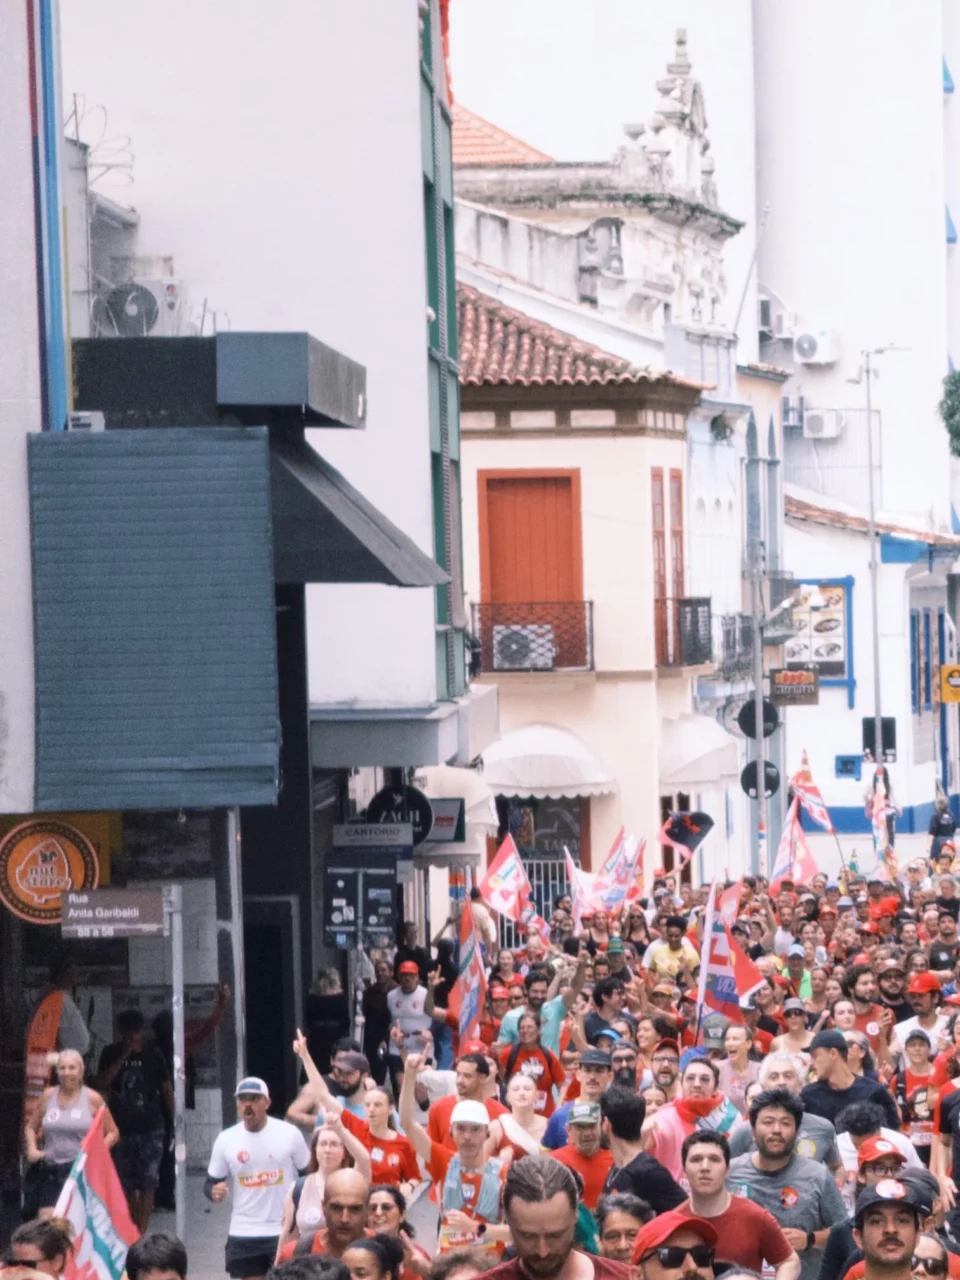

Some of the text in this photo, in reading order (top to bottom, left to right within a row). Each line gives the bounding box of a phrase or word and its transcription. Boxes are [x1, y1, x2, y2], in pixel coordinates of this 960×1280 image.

[68, 893, 88, 904] Rua
[68, 907, 139, 918] Anita Garibaldi
[92, 929, 99, 937] a
